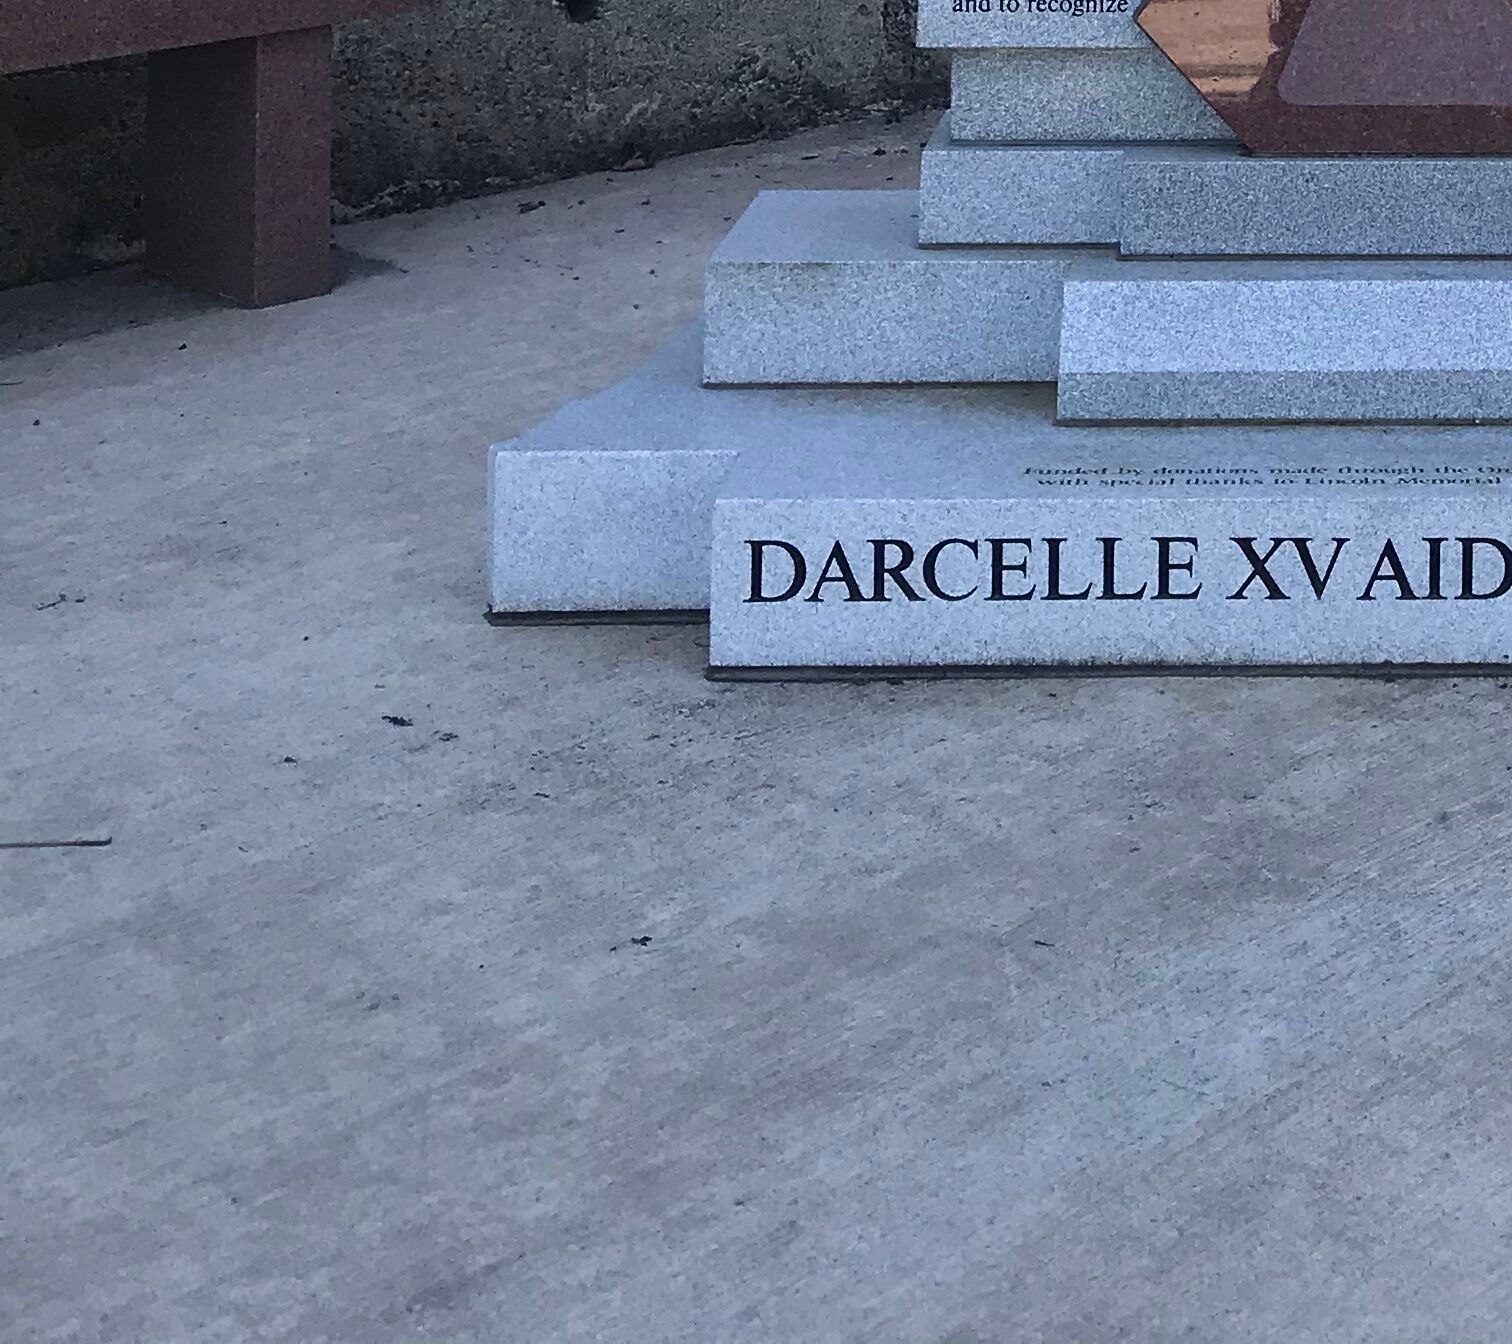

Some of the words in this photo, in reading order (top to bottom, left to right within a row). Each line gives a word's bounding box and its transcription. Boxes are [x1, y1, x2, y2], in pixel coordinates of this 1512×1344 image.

[1023, 466, 1109, 475] Funded
[1116, 466, 1144, 477] by
[1152, 466, 1259, 475] donations
[1269, 466, 1328, 475] made
[1337, 465, 1425, 476] through
[1434, 465, 1469, 474] the
[1036, 477, 1089, 486] with
[1098, 477, 1175, 487] special
[1185, 477, 1265, 486] thanks
[1304, 477, 1386, 485] Lincoln
[1397, 477, 1501, 485] Memorial
[743, 537, 1202, 602] DARCELLE
[1226, 537, 1350, 600] XV
